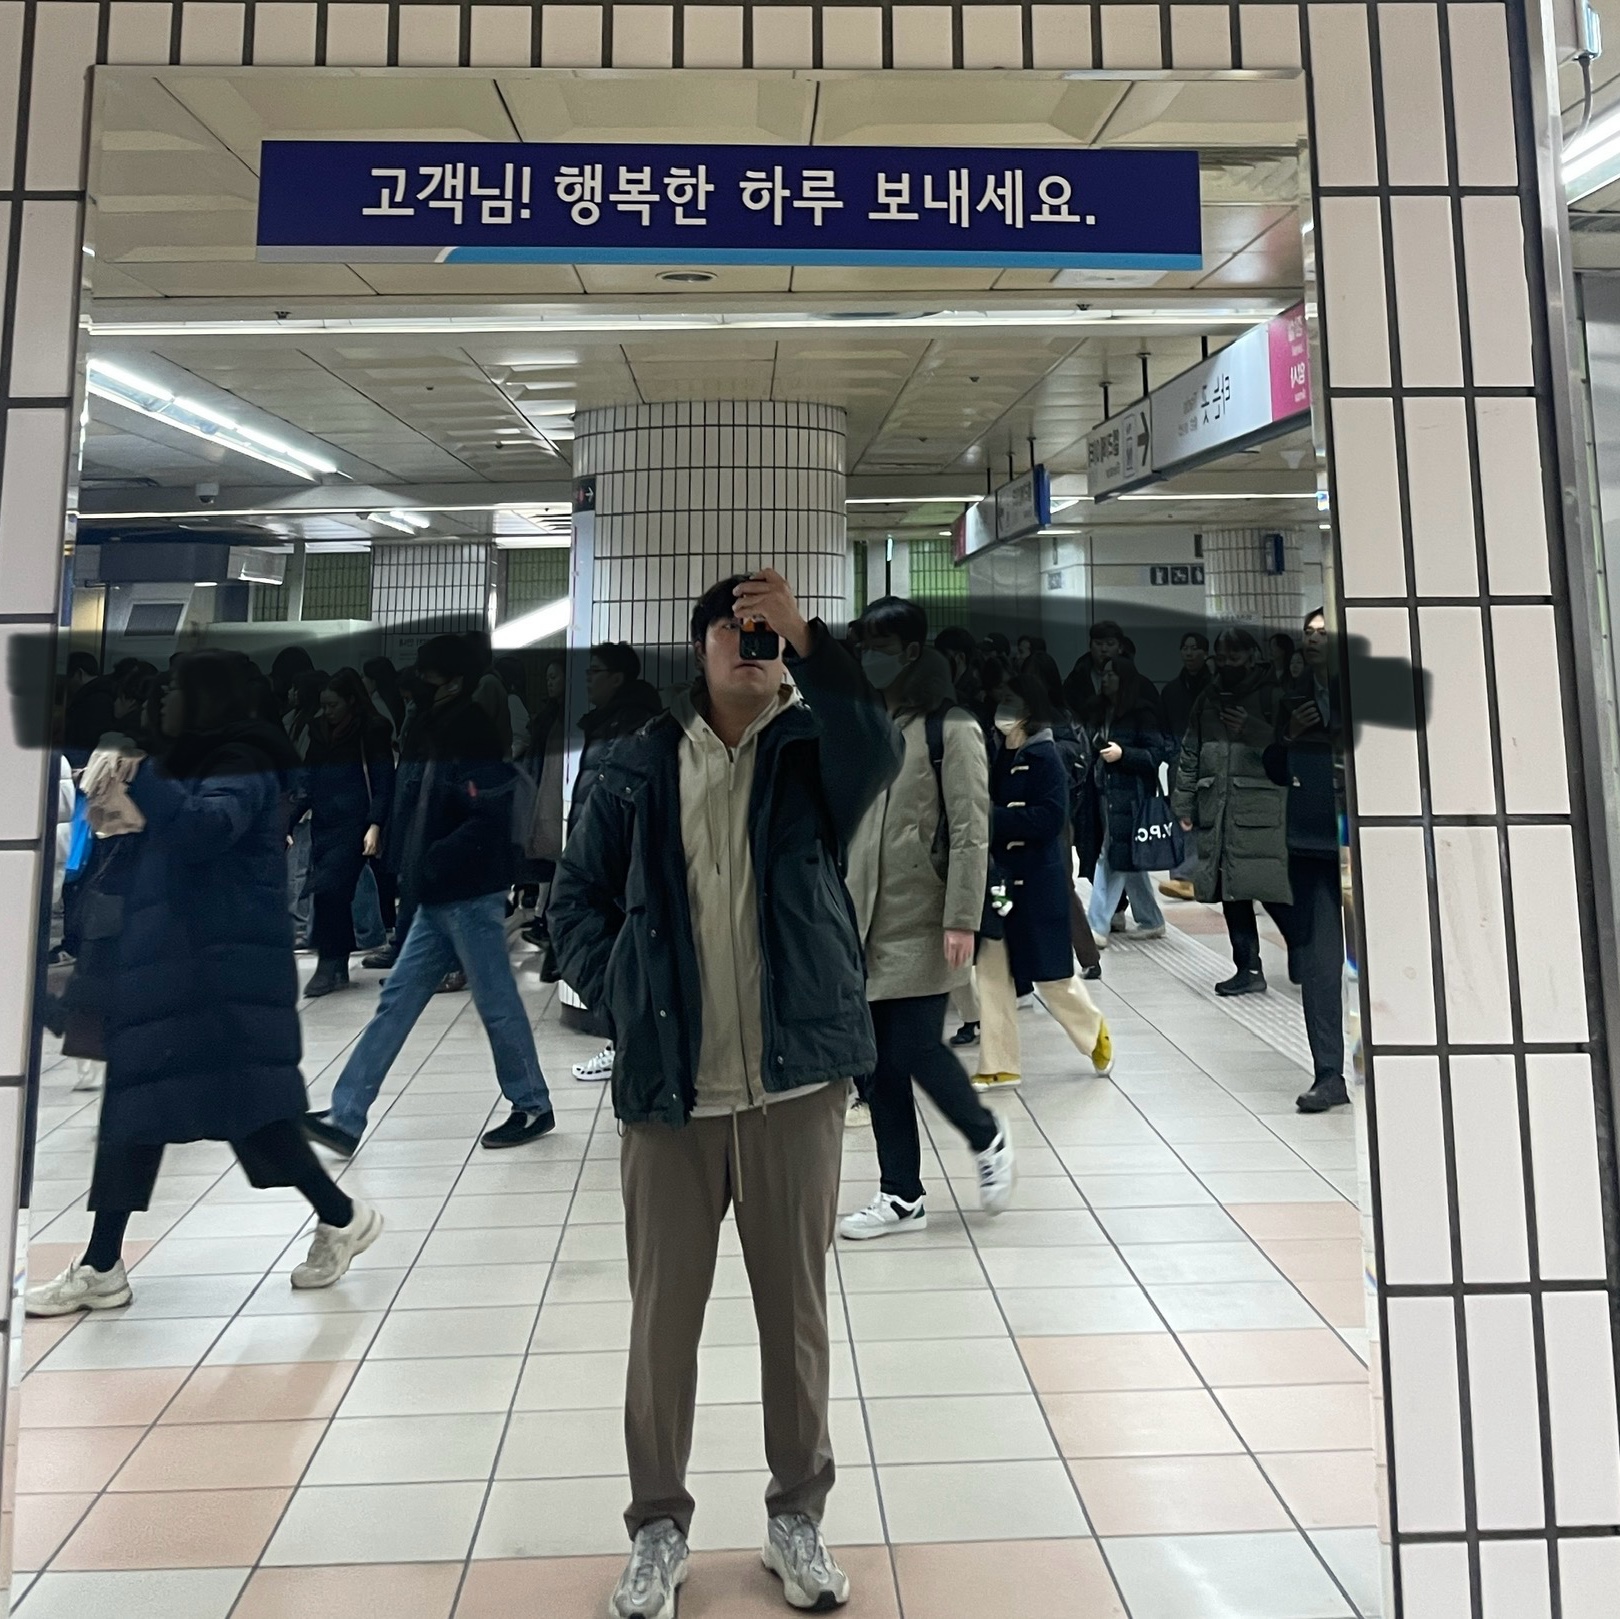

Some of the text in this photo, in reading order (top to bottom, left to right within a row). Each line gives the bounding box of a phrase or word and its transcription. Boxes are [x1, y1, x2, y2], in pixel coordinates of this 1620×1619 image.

[362, 162, 1096, 229] 고객님! 행복한 하루 보내세요.
